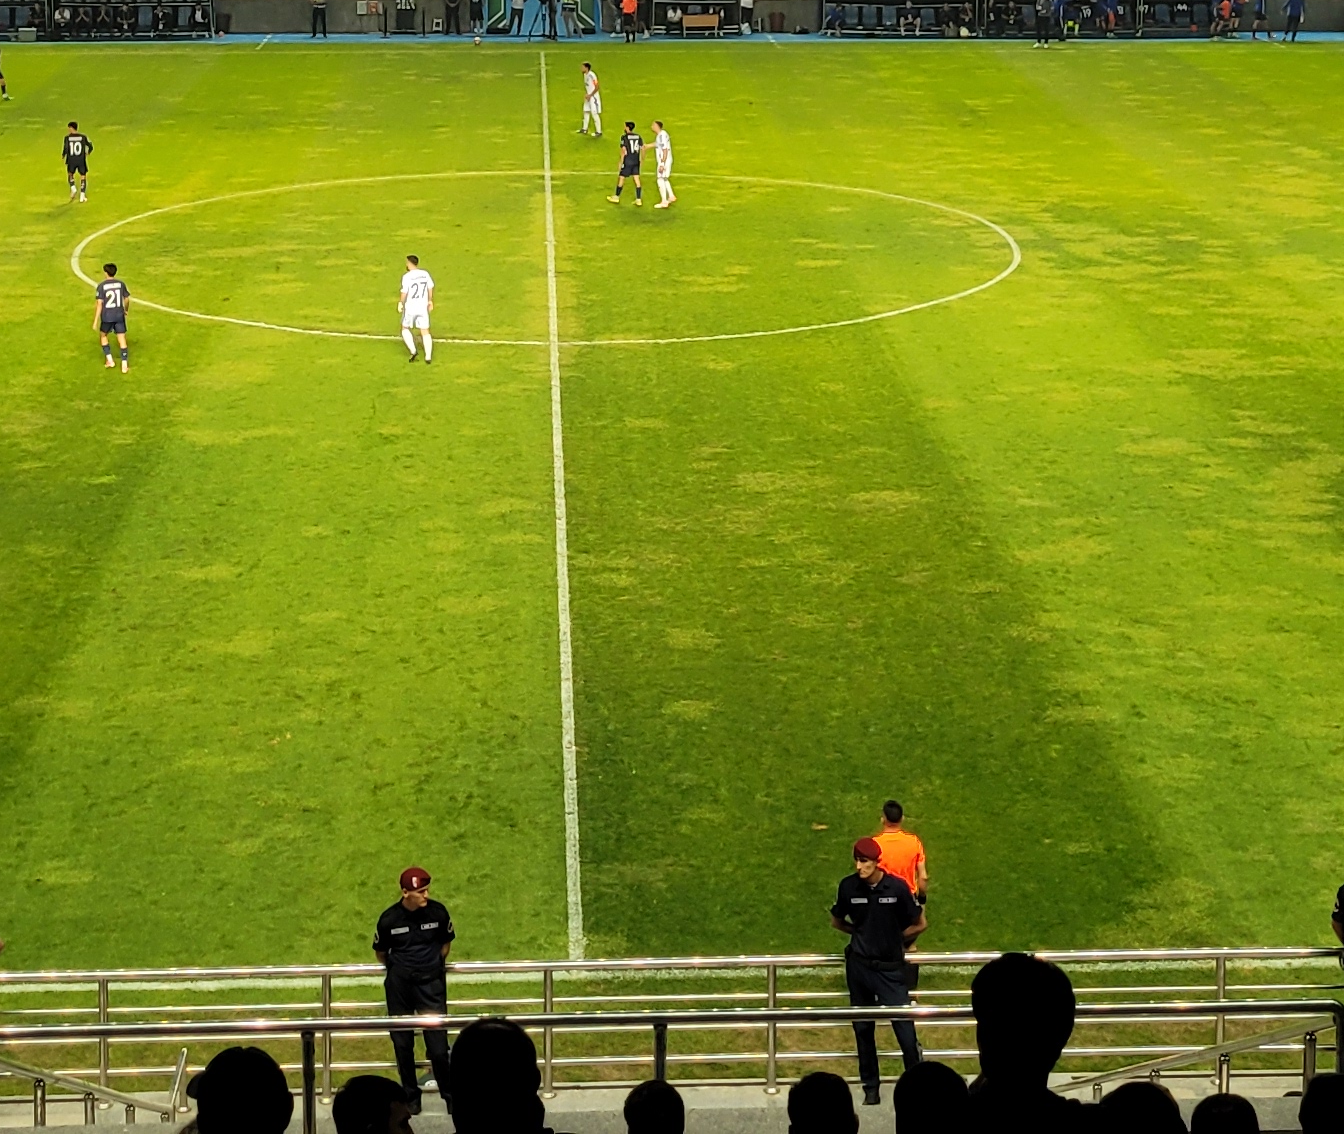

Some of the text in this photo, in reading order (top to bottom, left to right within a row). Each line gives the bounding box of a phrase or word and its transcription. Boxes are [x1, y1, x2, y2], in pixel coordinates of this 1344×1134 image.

[69, 141, 82, 156] 10
[105, 288, 121, 308] 21
[410, 281, 427, 299] 27
